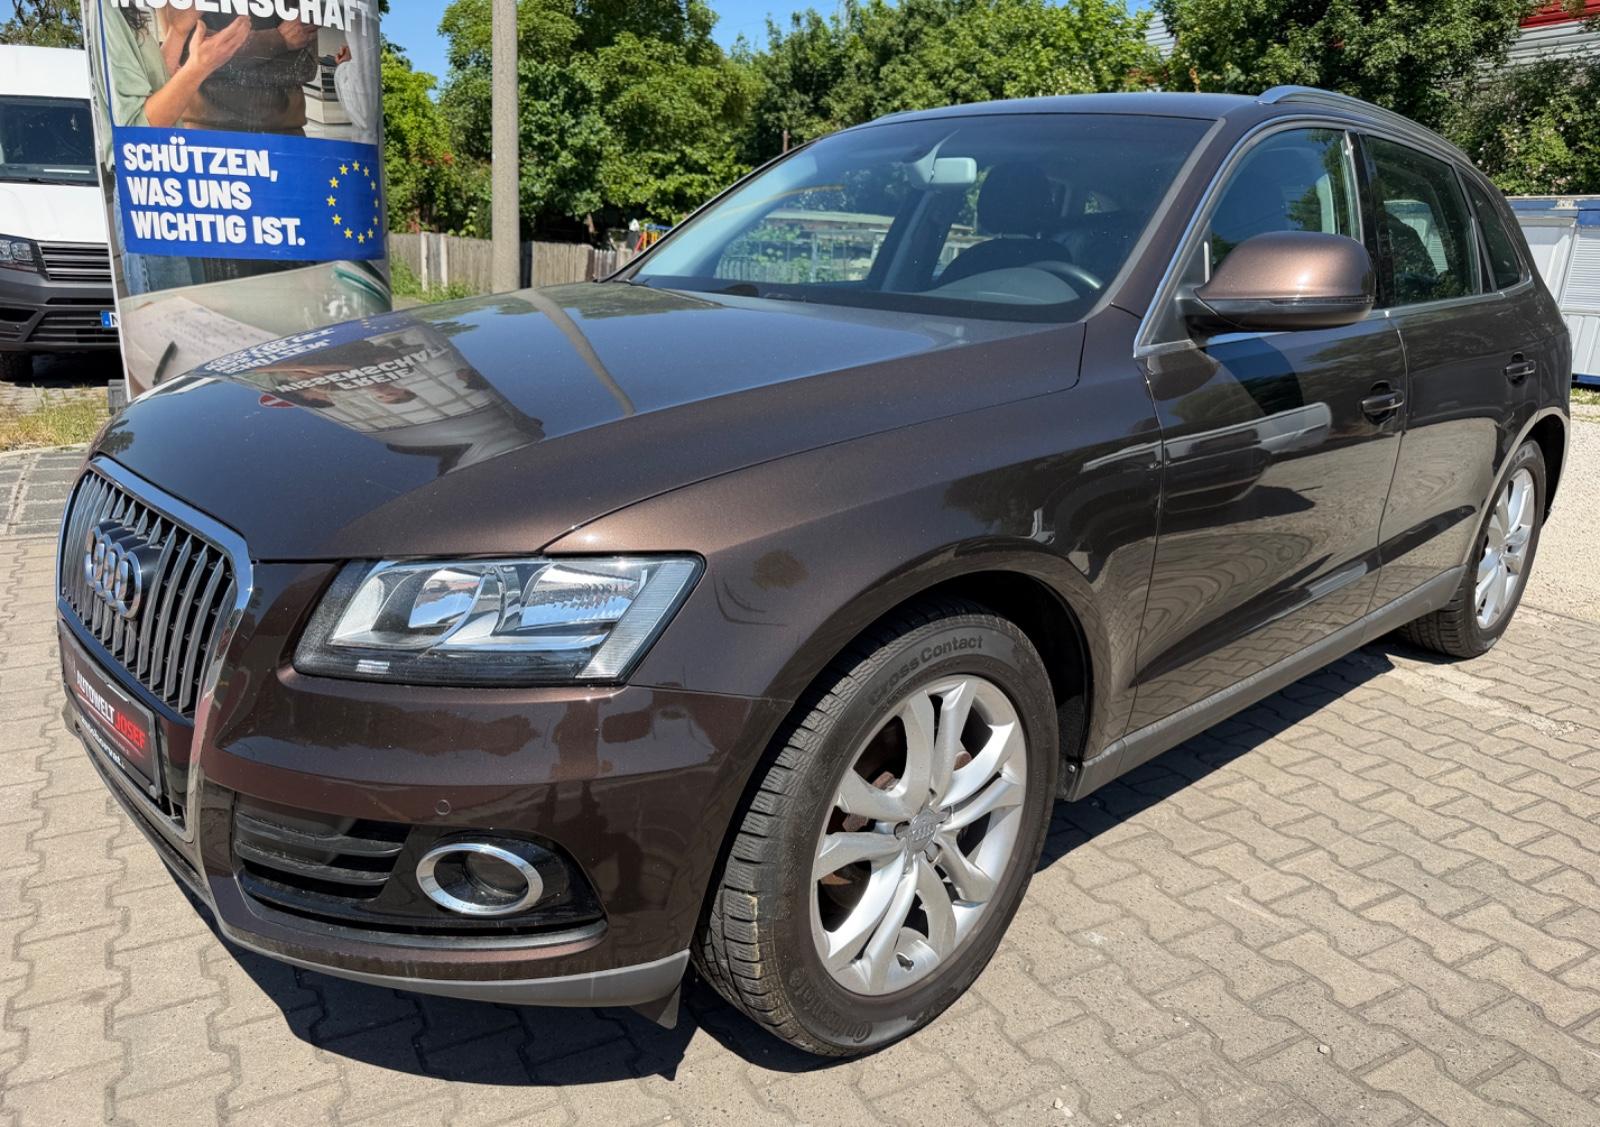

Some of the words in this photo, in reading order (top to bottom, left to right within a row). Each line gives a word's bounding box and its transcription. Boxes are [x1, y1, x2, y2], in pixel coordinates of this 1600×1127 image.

[123, 136, 278, 182] SCHÜTZEN,
[127, 177, 184, 207] WAS
[188, 180, 252, 210] UNS
[131, 211, 247, 244] WICHTIG
[252, 216, 306, 247] IST.
[76, 669, 115, 724] AUTOWELT
[115, 712, 145, 748] JOSEF
